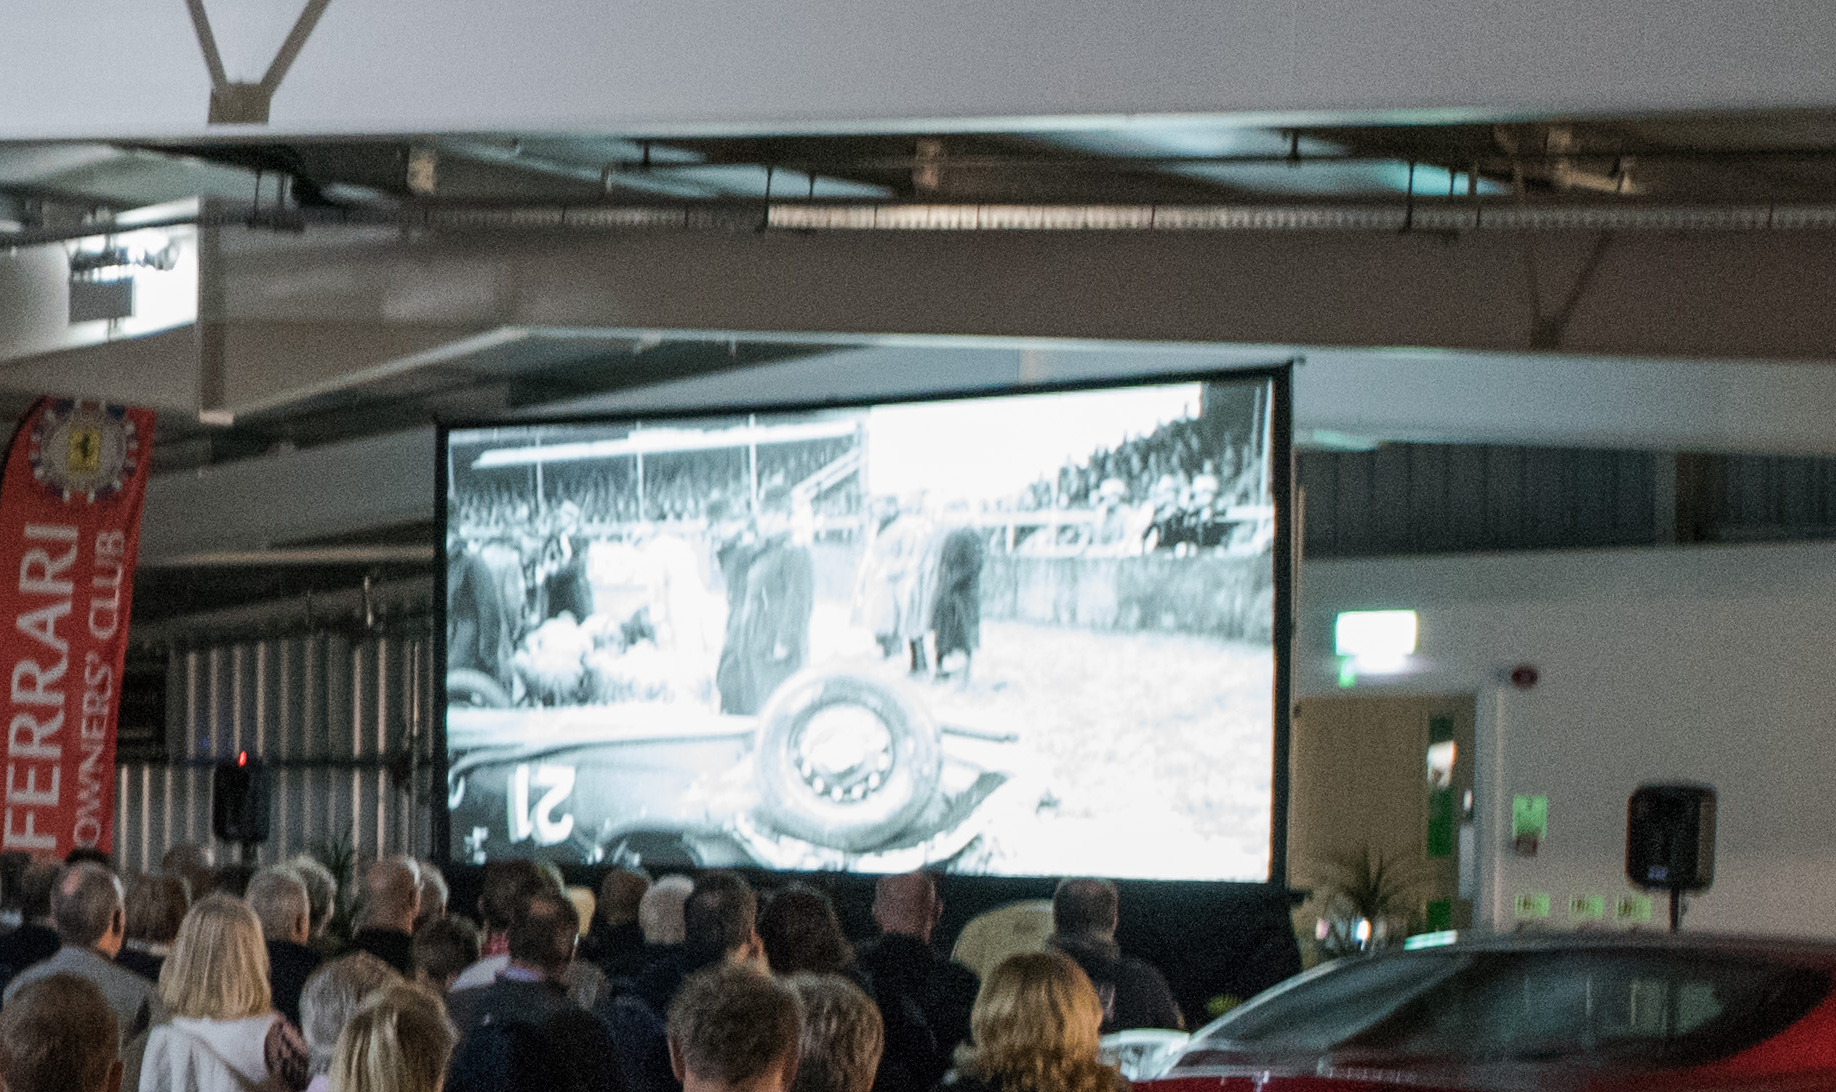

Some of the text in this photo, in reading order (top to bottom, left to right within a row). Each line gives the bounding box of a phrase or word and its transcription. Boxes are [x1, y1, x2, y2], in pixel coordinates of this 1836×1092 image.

[2, 523, 79, 851] FERRARI
[72, 529, 126, 847] OWNERS' CLUB
